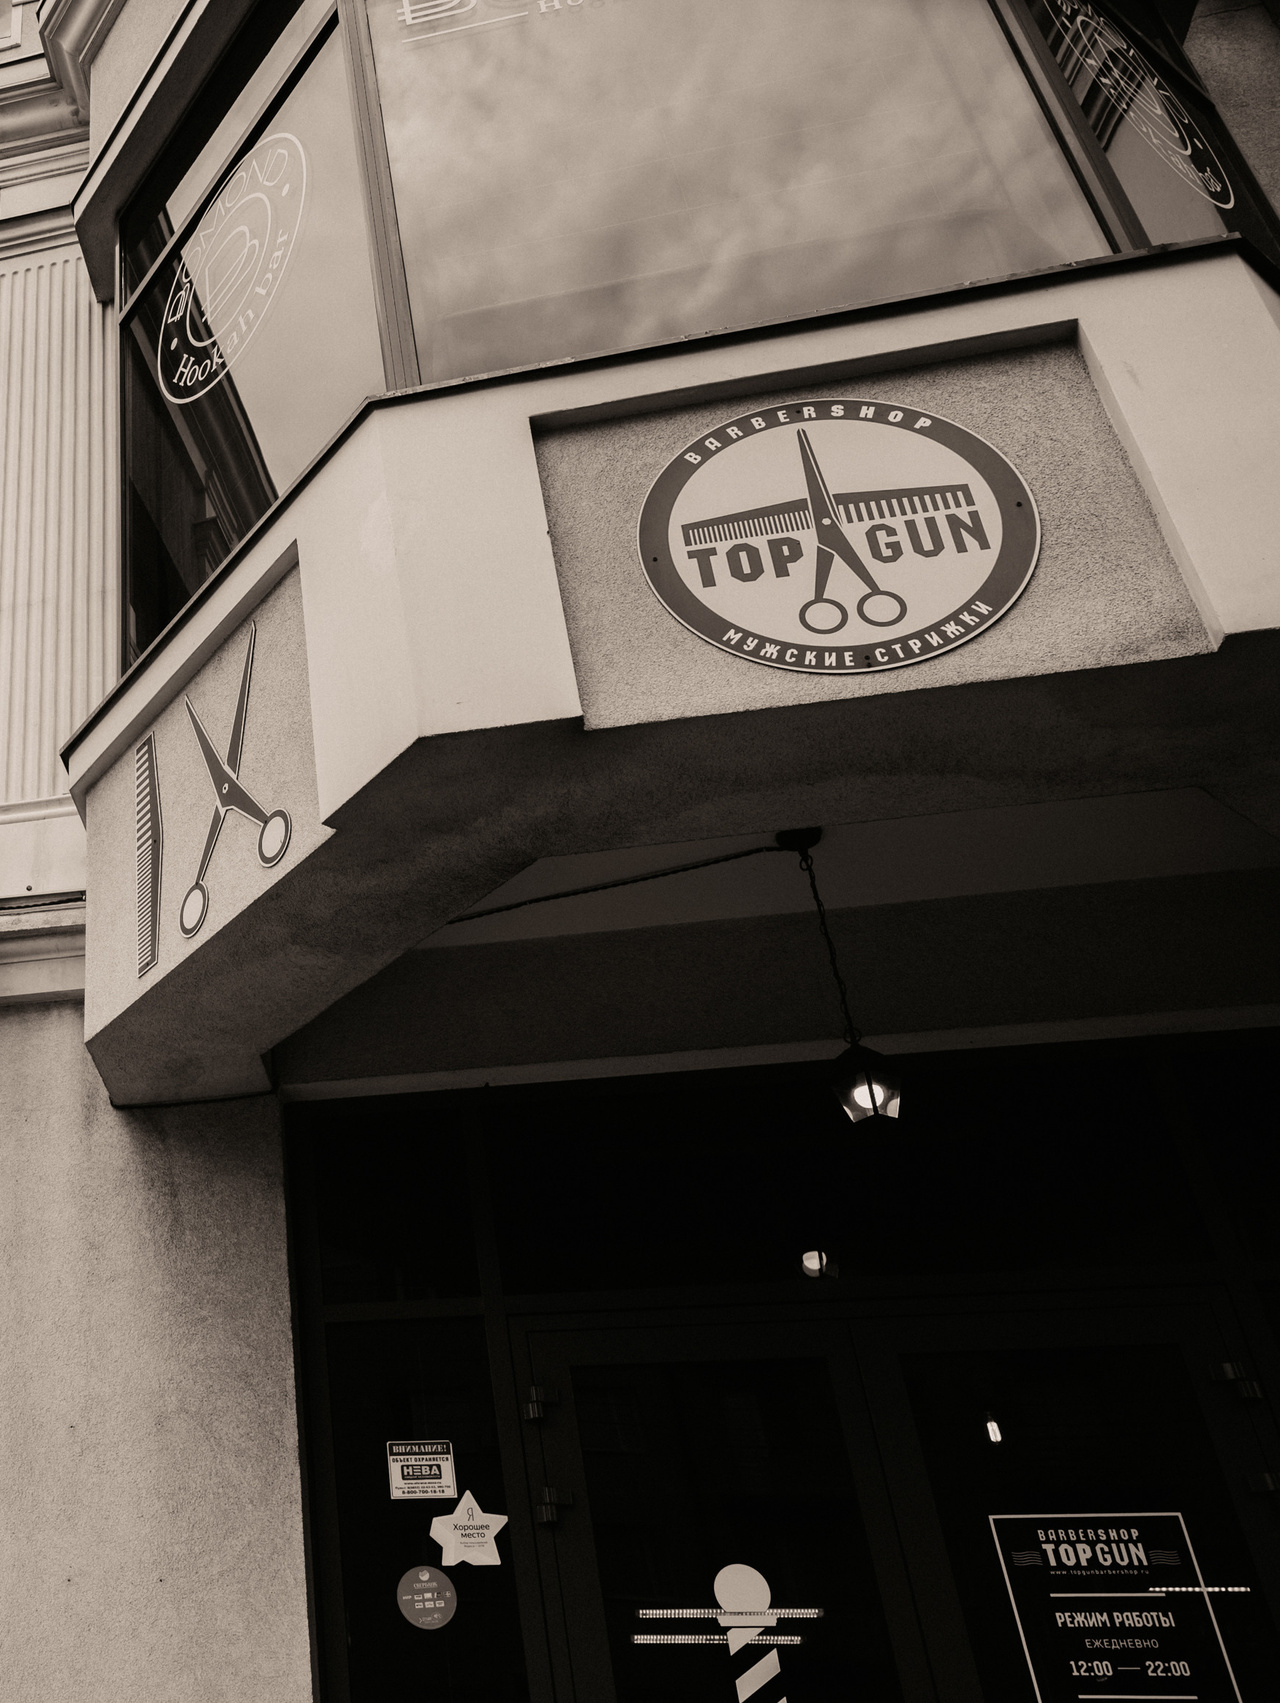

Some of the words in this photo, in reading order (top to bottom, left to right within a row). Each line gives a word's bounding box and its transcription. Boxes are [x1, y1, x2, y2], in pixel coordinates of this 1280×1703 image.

[173, 308, 256, 387] Hookah
[255, 229, 289, 296] bar
[684, 404, 933, 465] BARBERSHOP
[687, 536, 804, 588] TOP
[864, 510, 992, 564] GUN
[723, 628, 855, 667] МУЖСКИЕ
[874, 600, 993, 664] СТРИЖКИ
[392, 1444, 447, 1453] ВНИМАНИЕ!
[452, 1523, 490, 1532] Хорошее
[1036, 1528, 1140, 1541] BARBERSHOP
[1055, 1612, 1111, 1628] РЕЖИМ
[1113, 1611, 1176, 1628] РАБОТЫ
[1084, 1638, 1159, 1650] ЕЖЕДНЕВНО
[1069, 1661, 1113, 1677] 12:00
[1145, 1661, 1191, 1677] 22:00
